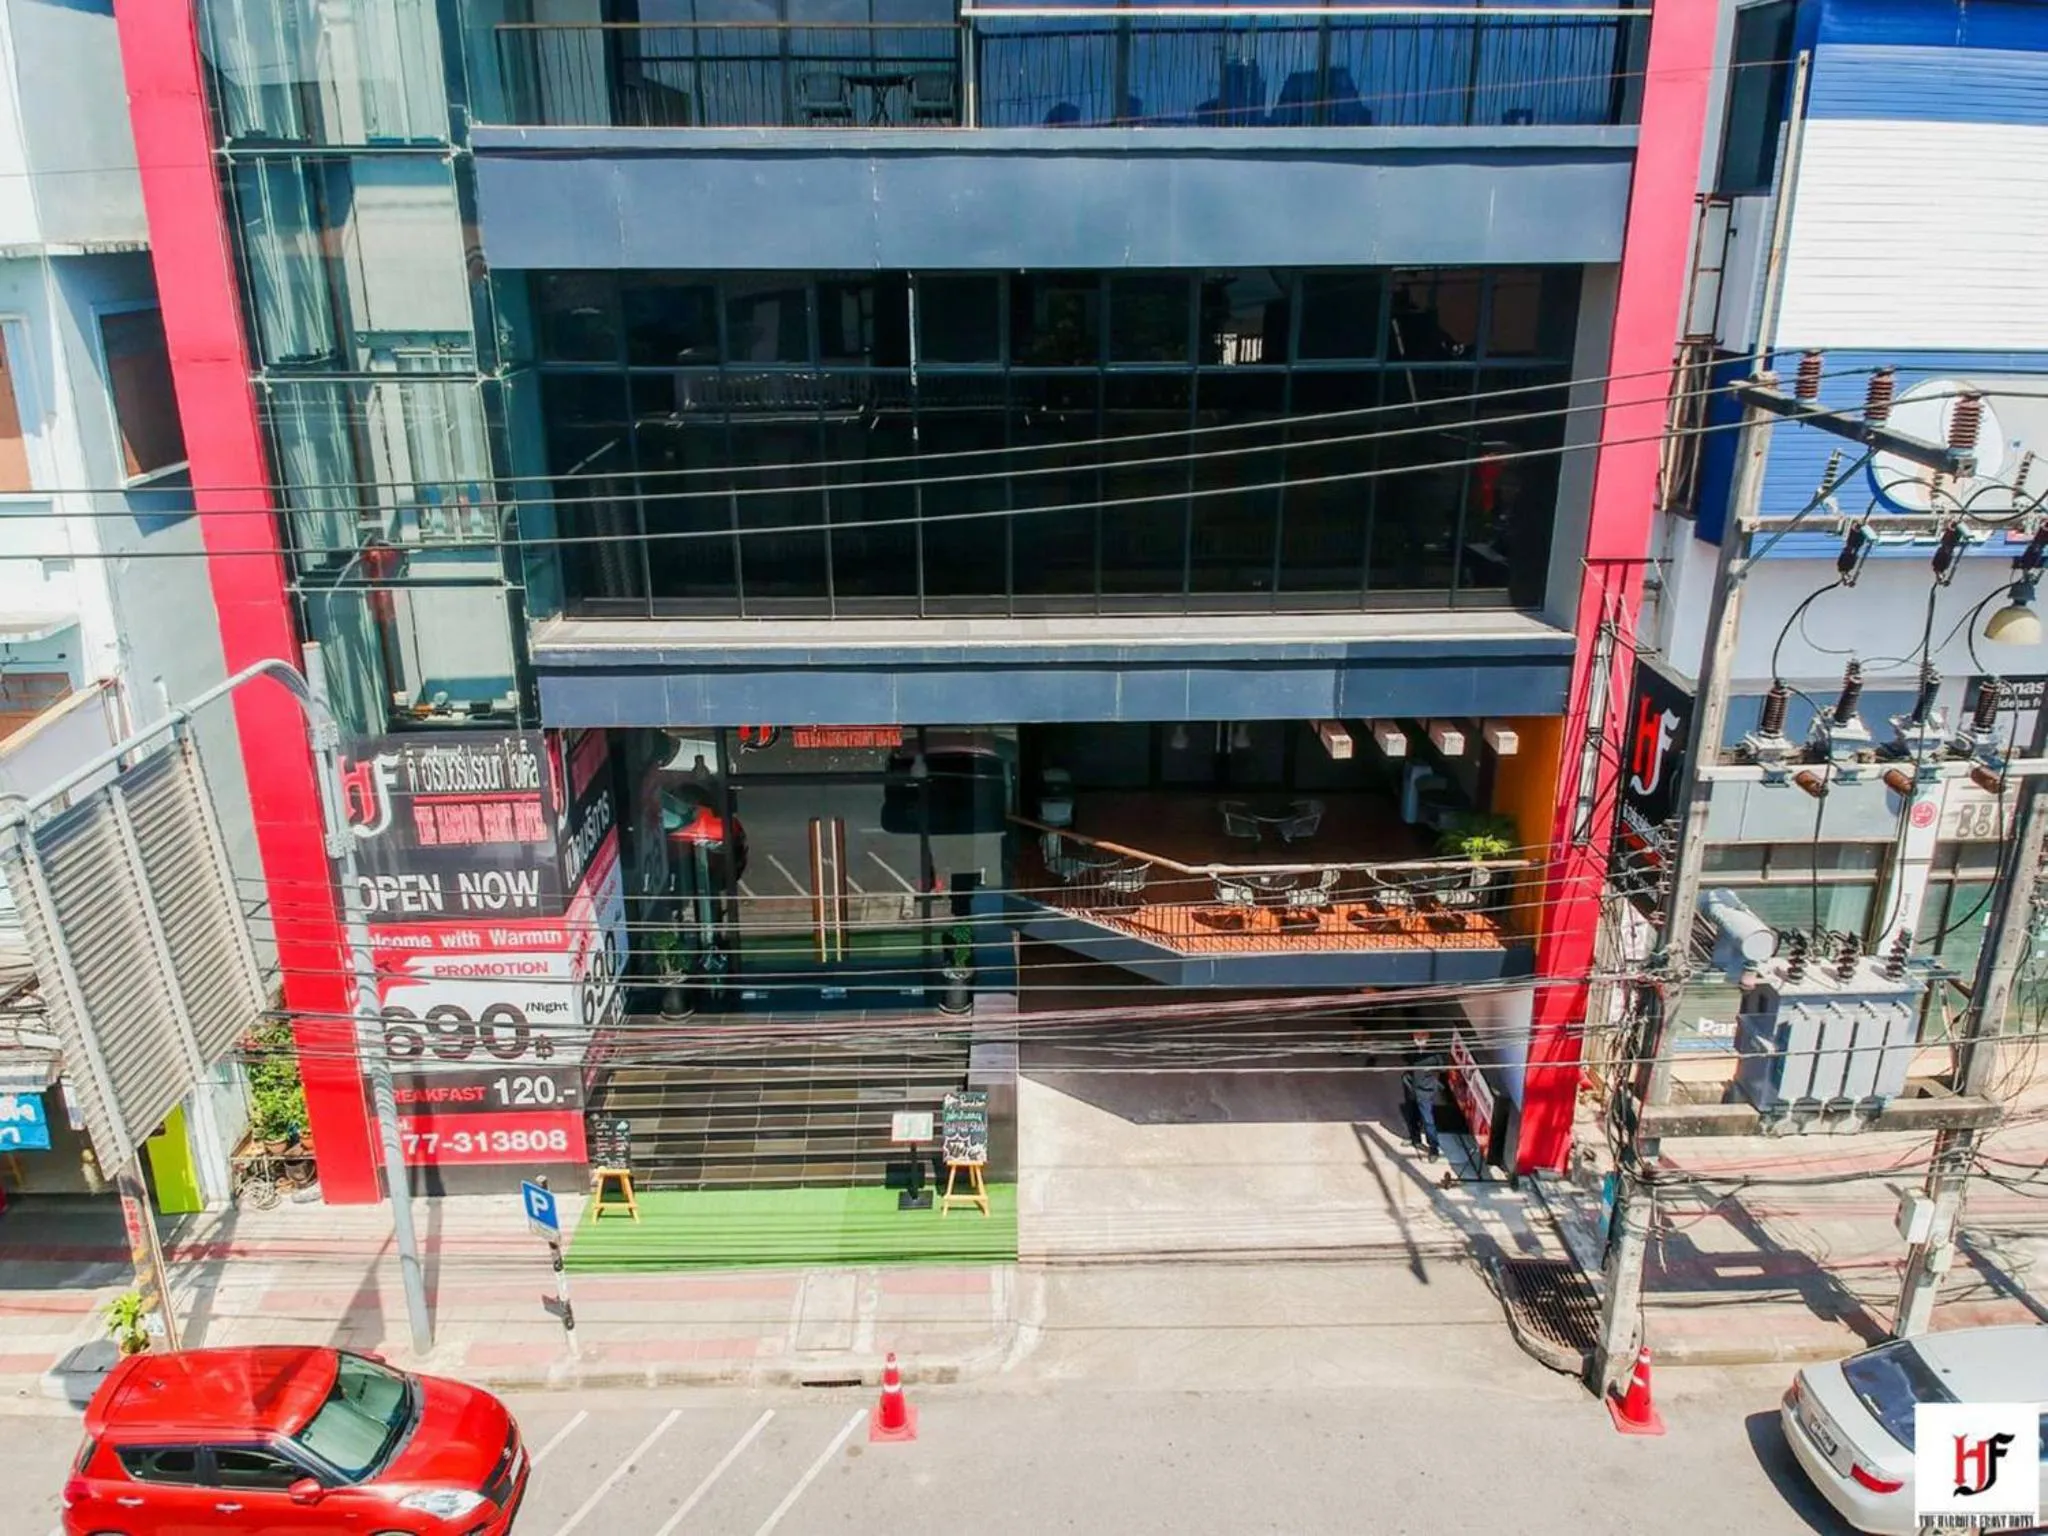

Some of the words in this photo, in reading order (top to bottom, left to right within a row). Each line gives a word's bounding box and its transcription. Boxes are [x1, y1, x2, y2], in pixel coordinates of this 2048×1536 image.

[358, 873, 445, 914] OPEN
[459, 870, 541, 910] NOW
[440, 929, 481, 948] with
[433, 960, 550, 977] PROMOTION
[380, 1002, 532, 1062] 690
[524, 1002, 570, 1015] /Night
[492, 1075, 577, 1106] 120.-
[529, 1189, 549, 1217] P
